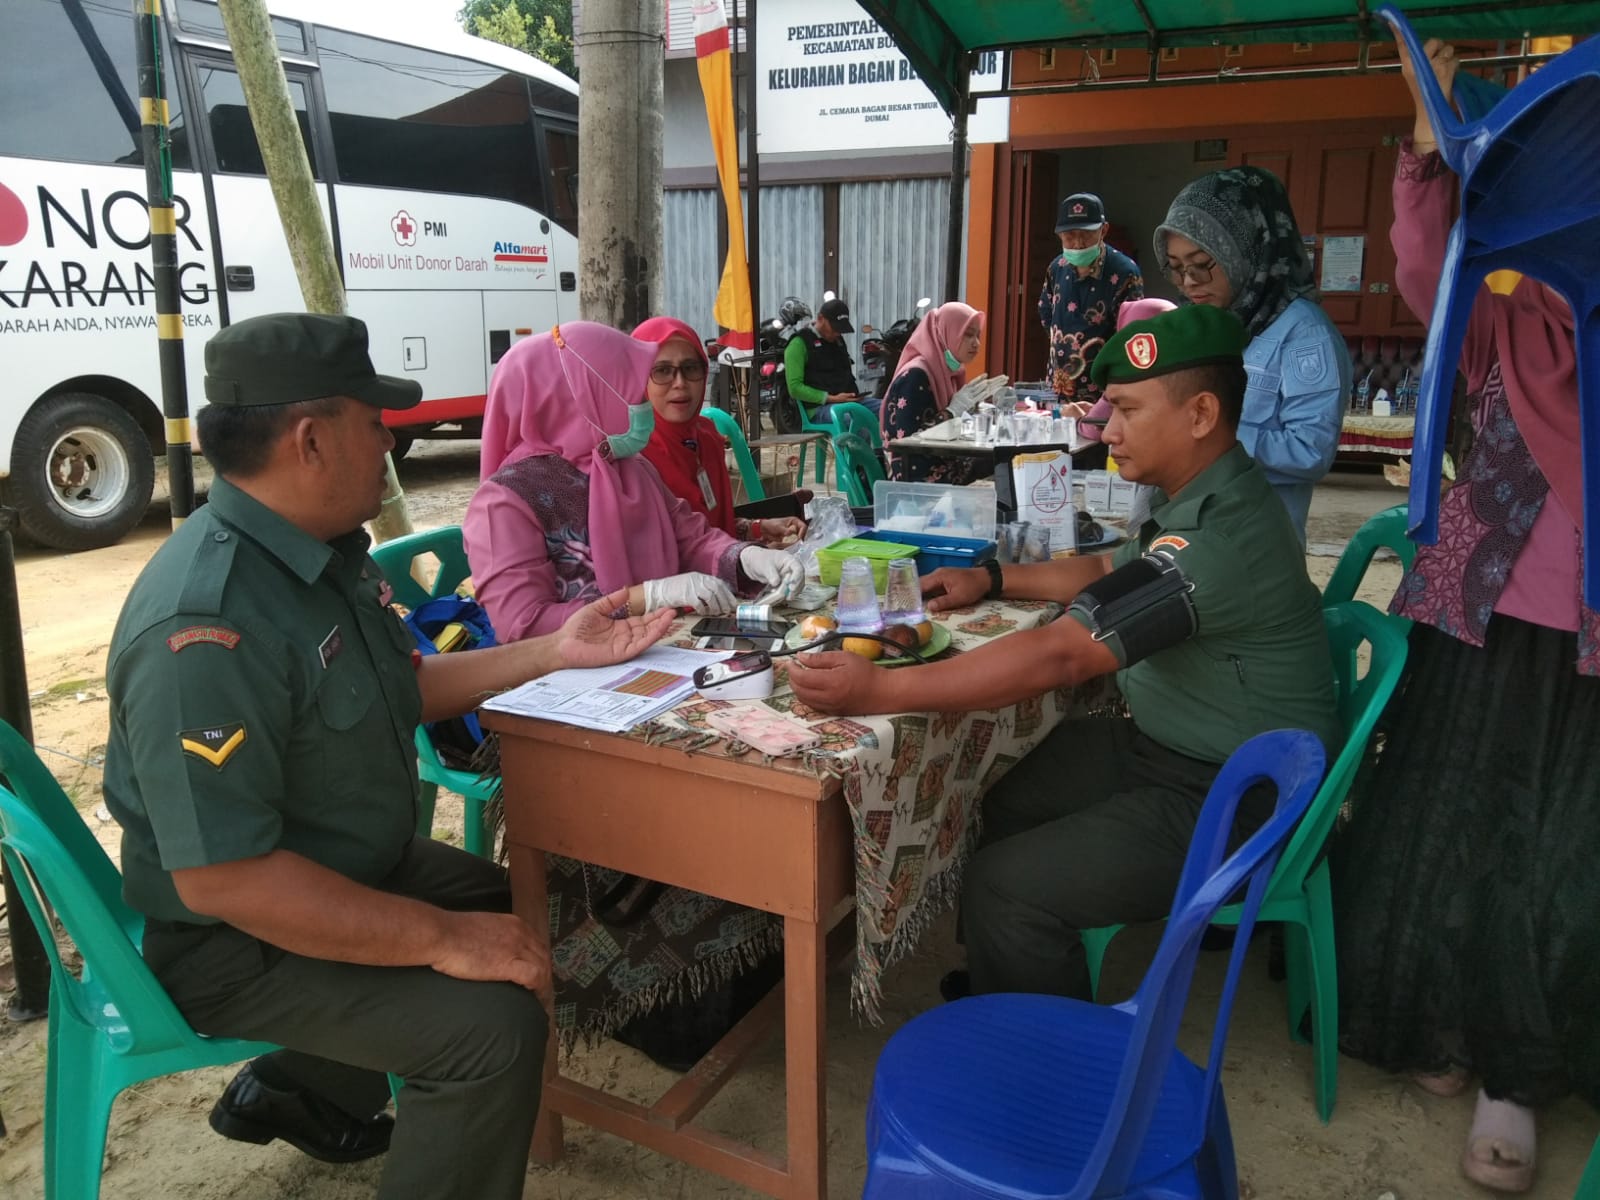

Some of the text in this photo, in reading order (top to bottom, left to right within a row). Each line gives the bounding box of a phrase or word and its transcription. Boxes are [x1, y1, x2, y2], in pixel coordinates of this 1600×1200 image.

[787, 19, 880, 41] PEMERINTAH
[803, 36, 897, 55] KECAMATAN BU
[768, 64, 845, 90] KELURAHAN
[848, 60, 895, 85] BAGAN
[899, 59, 918, 80] BE
[830, 107, 860, 115] CEMARA
[861, 105, 887, 113] BAGAN
[888, 103, 912, 112] BESAR
[913, 102, 938, 110] TIMUR
[424, 221, 448, 237] PMI
[493, 241, 548, 255] Alfamart
[349, 252, 385, 270] Mobil
[387, 254, 413, 270] Unit
[416, 255, 452, 271] Donor
[456, 256, 488, 272] Darah
[0, 314, 213, 333] ARAH ANDA, NYAWA REKA
[203, 729, 223, 740] TNI
